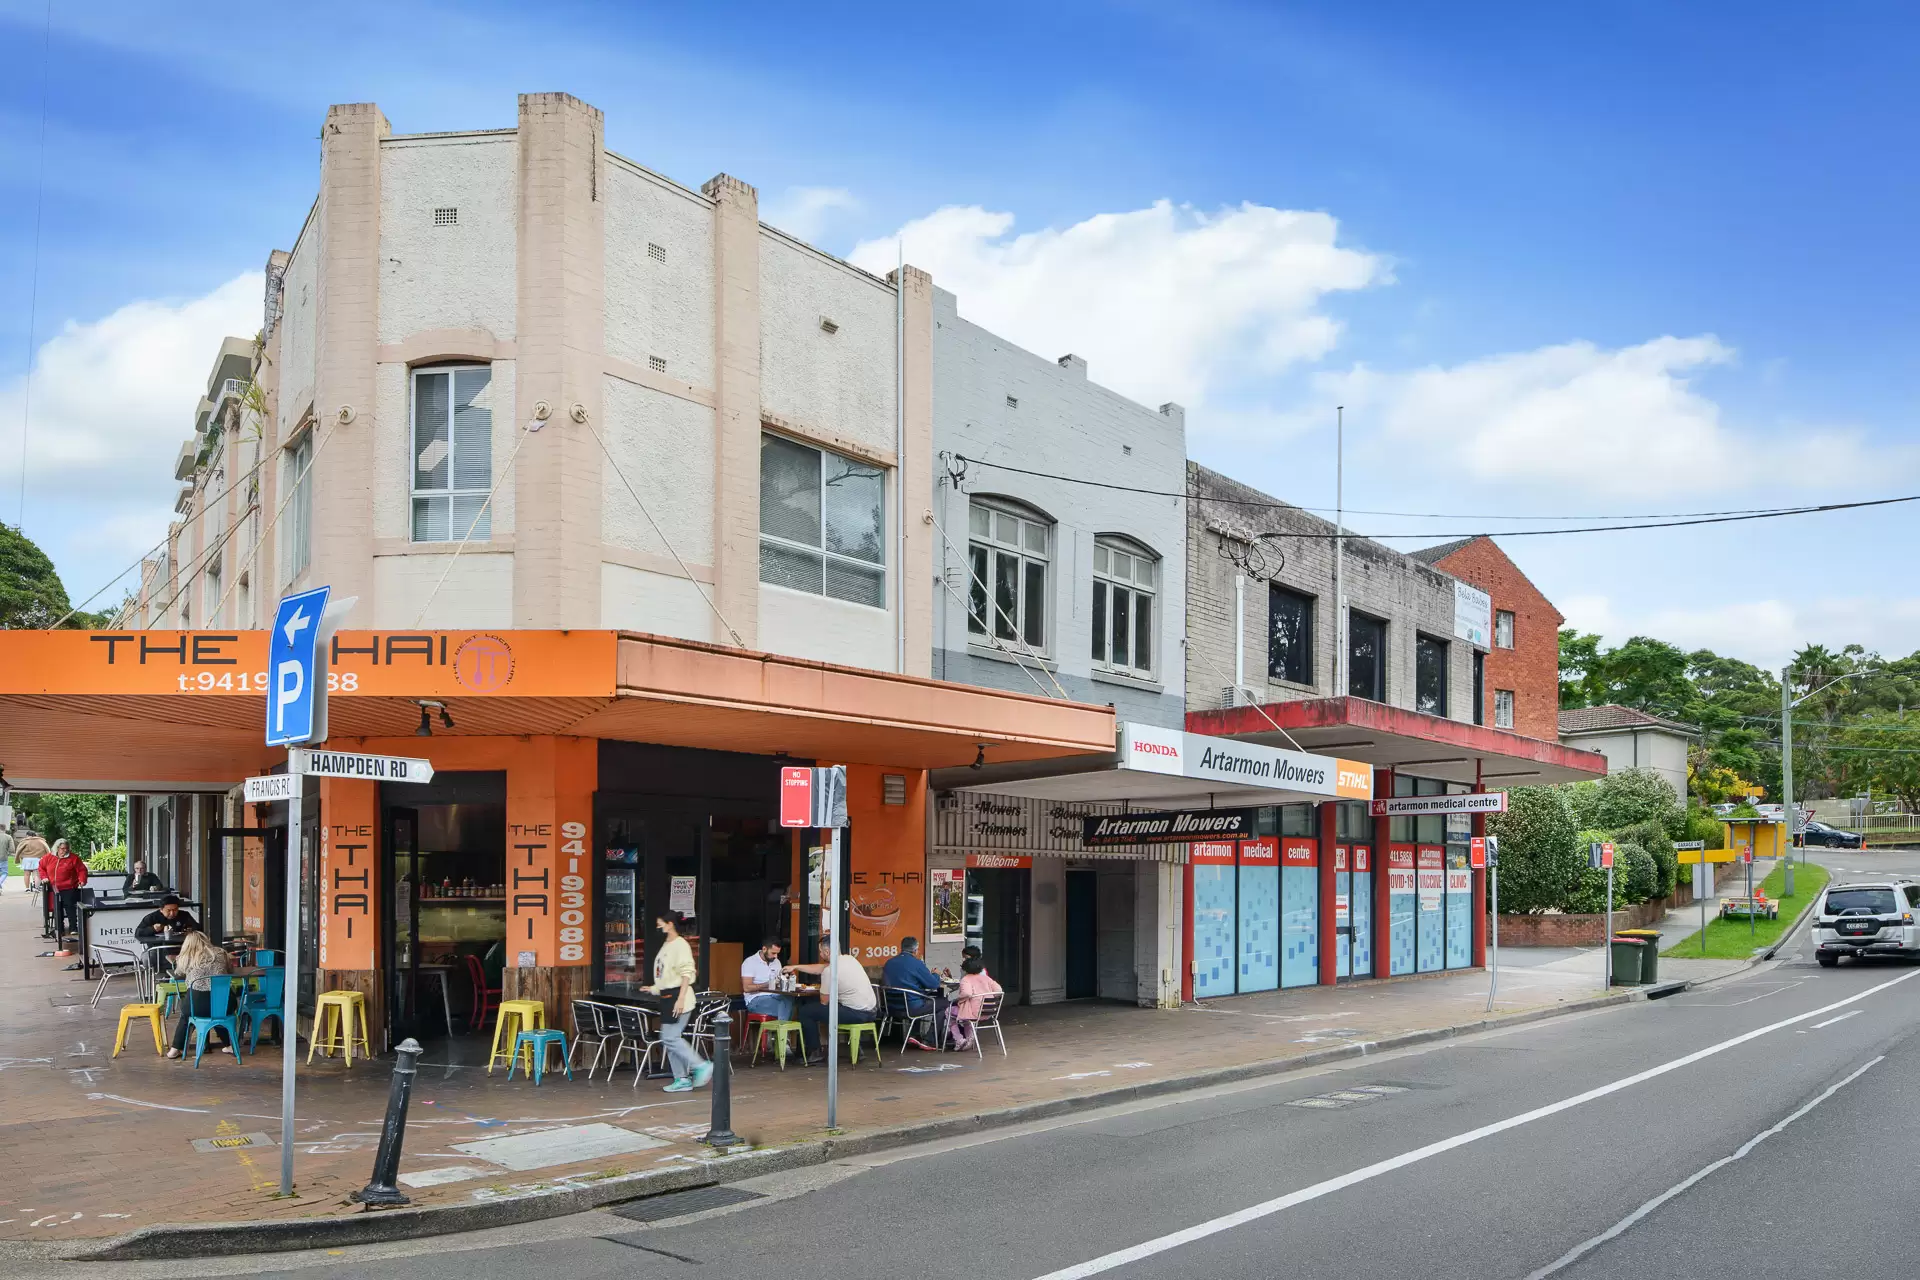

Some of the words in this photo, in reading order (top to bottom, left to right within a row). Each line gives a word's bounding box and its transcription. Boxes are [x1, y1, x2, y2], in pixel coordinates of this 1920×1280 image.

[90, 635, 239, 665] THE
[331, 635, 448, 666] HAI
[276, 659, 304, 732] P
[1133, 740, 1179, 758] HONDA
[311, 753, 385, 777] HAMPDEN
[390, 760, 407, 778] RD
[1200, 746, 1270, 778] Artarmon
[1273, 758, 1325, 785] Mowers
[251, 779, 281, 798] FRANCIS
[785, 779, 809, 787] STOPPING
[1337, 771, 1369, 790] STIHL
[979, 801, 1021, 817] Mowers
[1389, 801, 1429, 812] artarmon
[1430, 798, 1466, 810] medical
[1468, 798, 1498, 808] centre
[332, 825, 373, 836] THE
[510, 824, 552, 836] THE
[980, 822, 1027, 837] Trimmers
[1095, 818, 1170, 836] Artarmon
[1172, 813, 1242, 833] Mowers
[1193, 842, 1232, 858] artarmon
[1243, 843, 1273, 859] medical
[1288, 846, 1311, 860] centre
[975, 854, 1020, 867] Welcome
[879, 872, 923, 885] THAI
[1390, 874, 1414, 889] OVID-19
[1419, 874, 1442, 889] VACCINE
[1450, 874, 1467, 889] CLINIC
[334, 844, 368, 939] THAI
[513, 844, 549, 940] THAI
[560, 821, 586, 961] 94193088
[107, 938, 119, 946] Our
[865, 945, 898, 958] 3088
